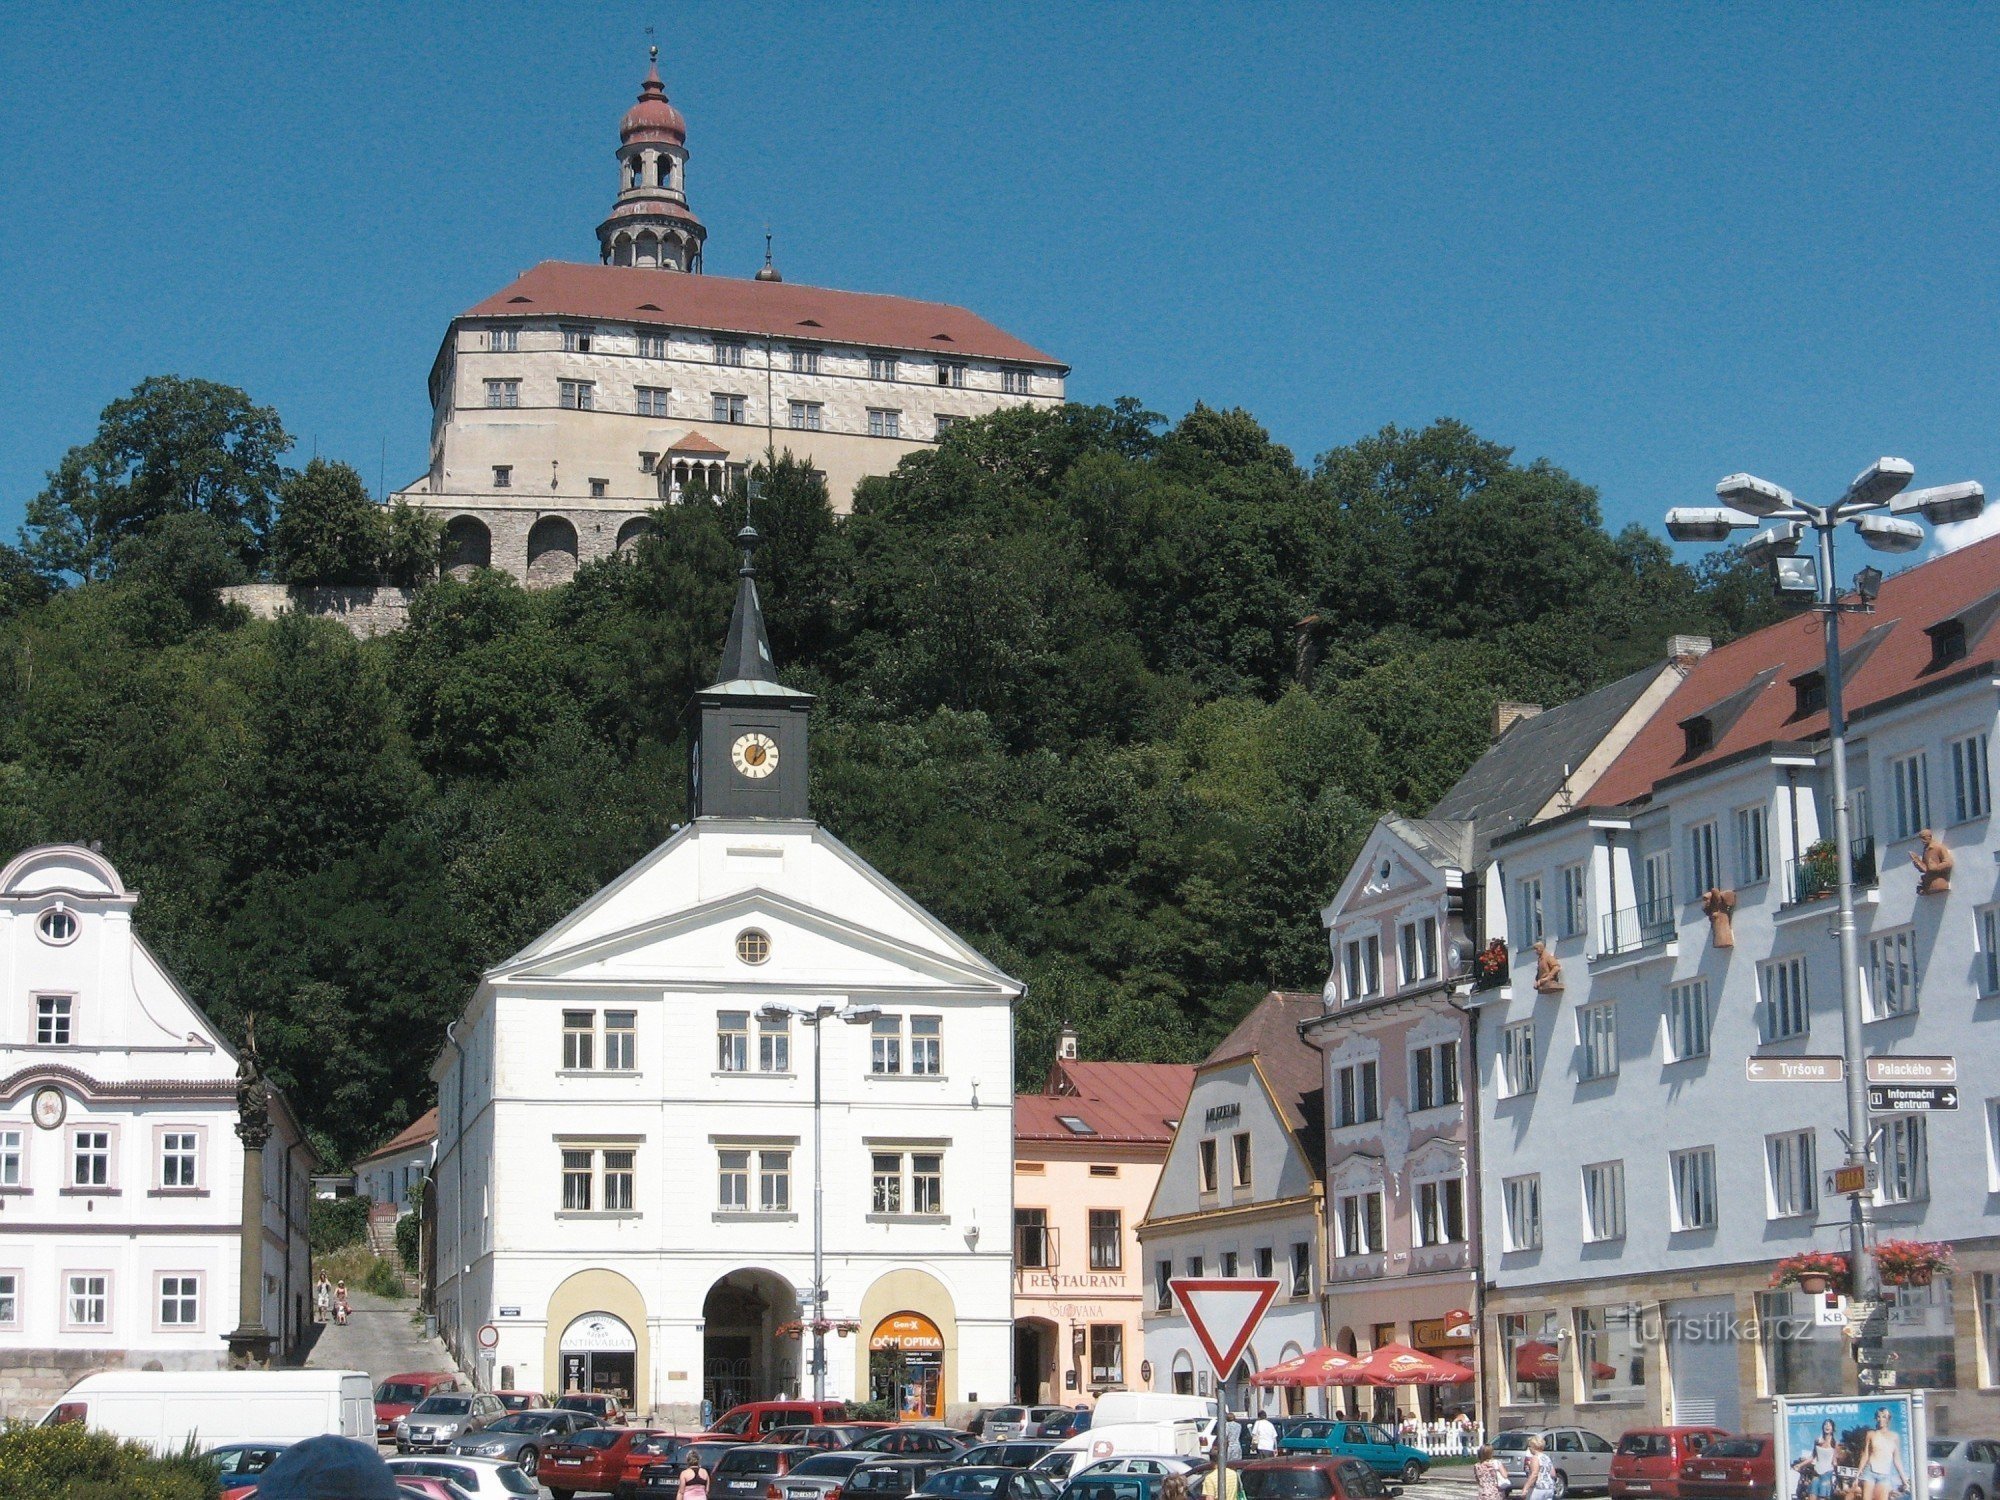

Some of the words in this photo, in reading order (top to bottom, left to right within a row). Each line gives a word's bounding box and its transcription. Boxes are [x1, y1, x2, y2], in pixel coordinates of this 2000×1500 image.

[1779, 1062, 1825, 1078] Tyršova
[1877, 1062, 1932, 1076] Palackého
[1887, 1088, 1936, 1099] Informační
[1893, 1100, 1931, 1109] centrum
[1030, 1274, 1127, 1288] RESTAURANT
[1822, 1312, 1843, 1323] KB
[903, 1336, 941, 1347] OPTIKA
[1787, 1404, 1824, 1416] EASY
[1825, 1403, 1859, 1415] GYM
